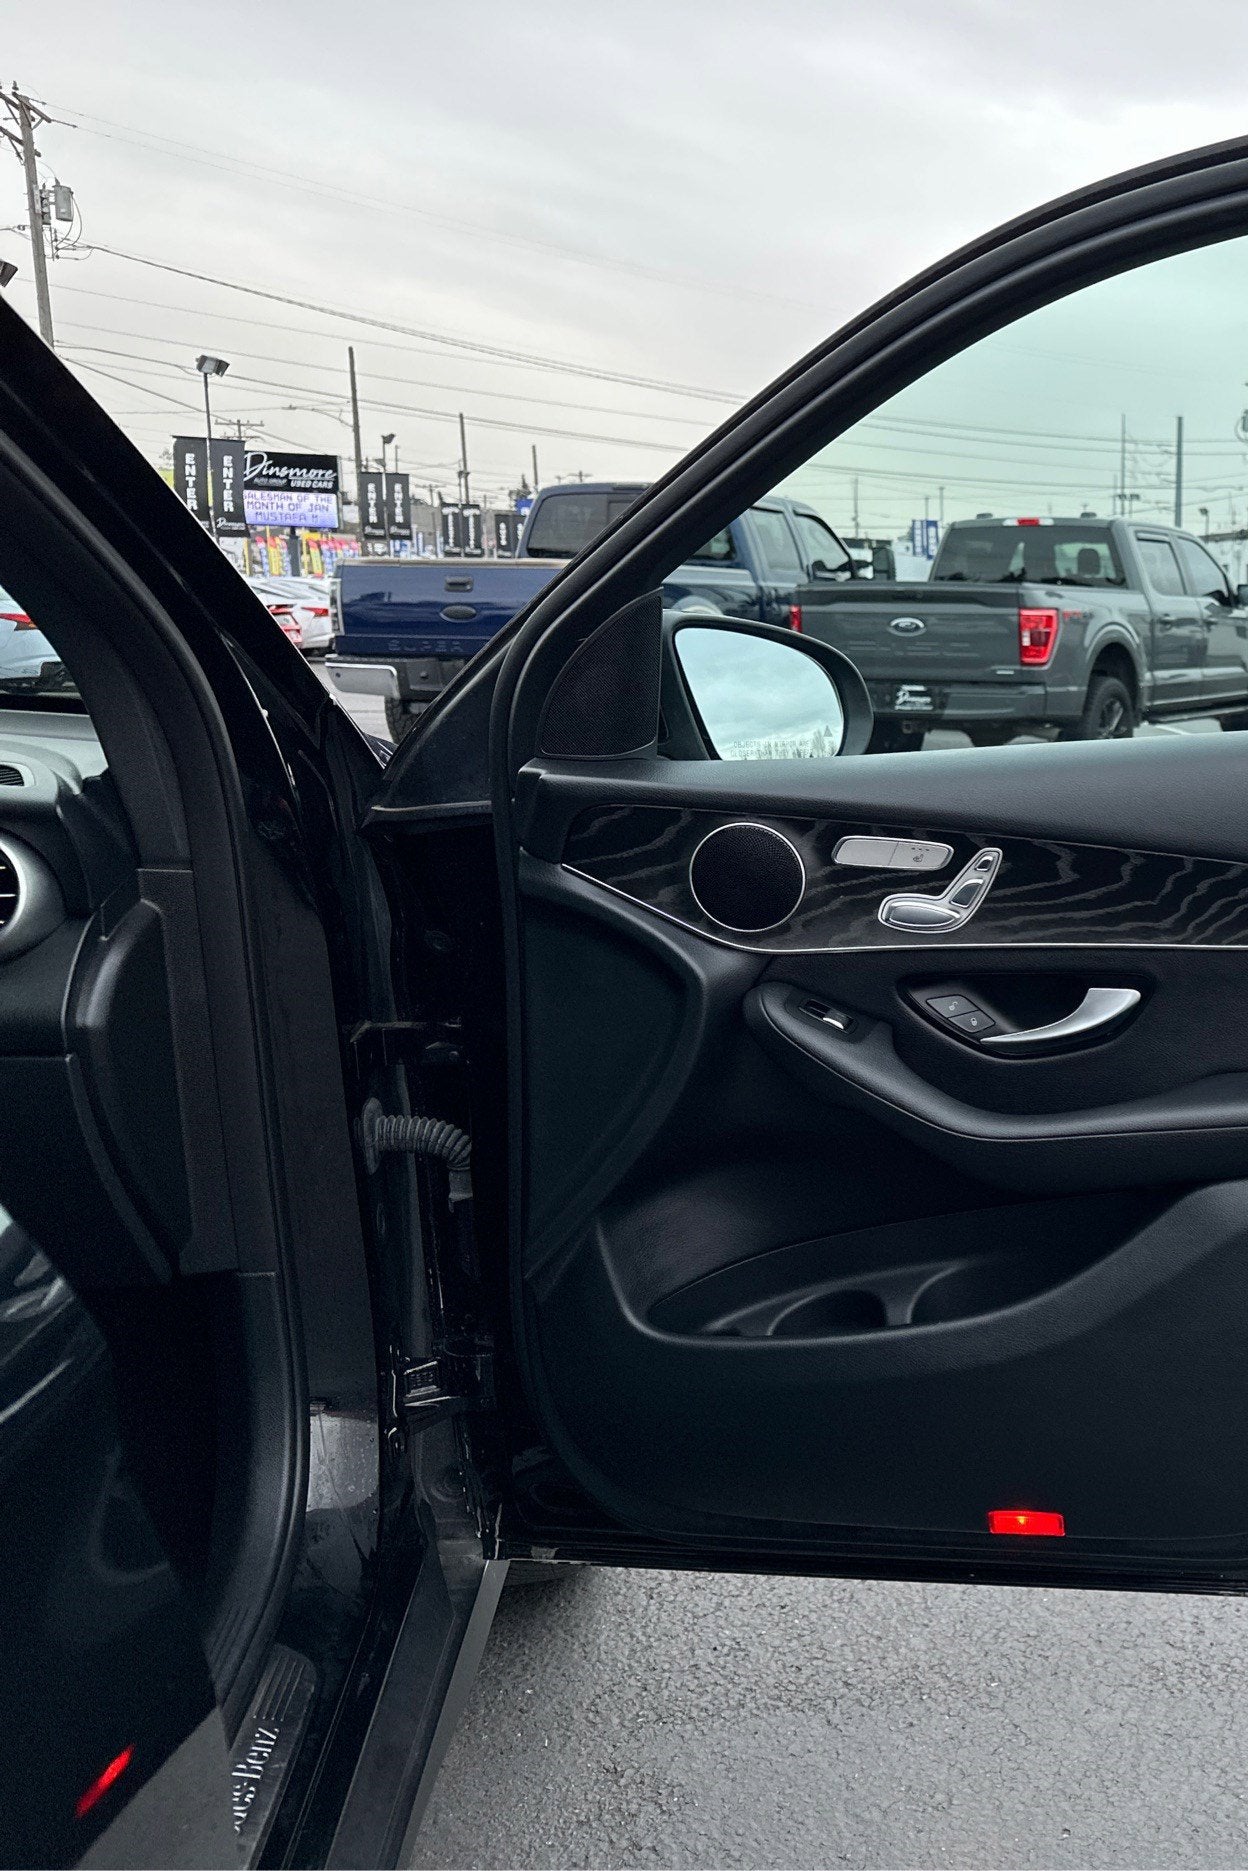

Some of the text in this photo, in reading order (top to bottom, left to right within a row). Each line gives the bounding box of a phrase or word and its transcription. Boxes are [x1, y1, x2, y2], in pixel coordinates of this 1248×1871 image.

[243, 452, 337, 481] Dinsmore
[185, 453, 197, 510] ENTER
[222, 455, 234, 512] ENTER
[290, 480, 334, 489] USED CARS
[297, 494, 309, 502] OF
[314, 494, 332, 504] THE
[247, 501, 329, 512] MONTH OF JAN
[255, 512, 307, 521] MUSTAFA
